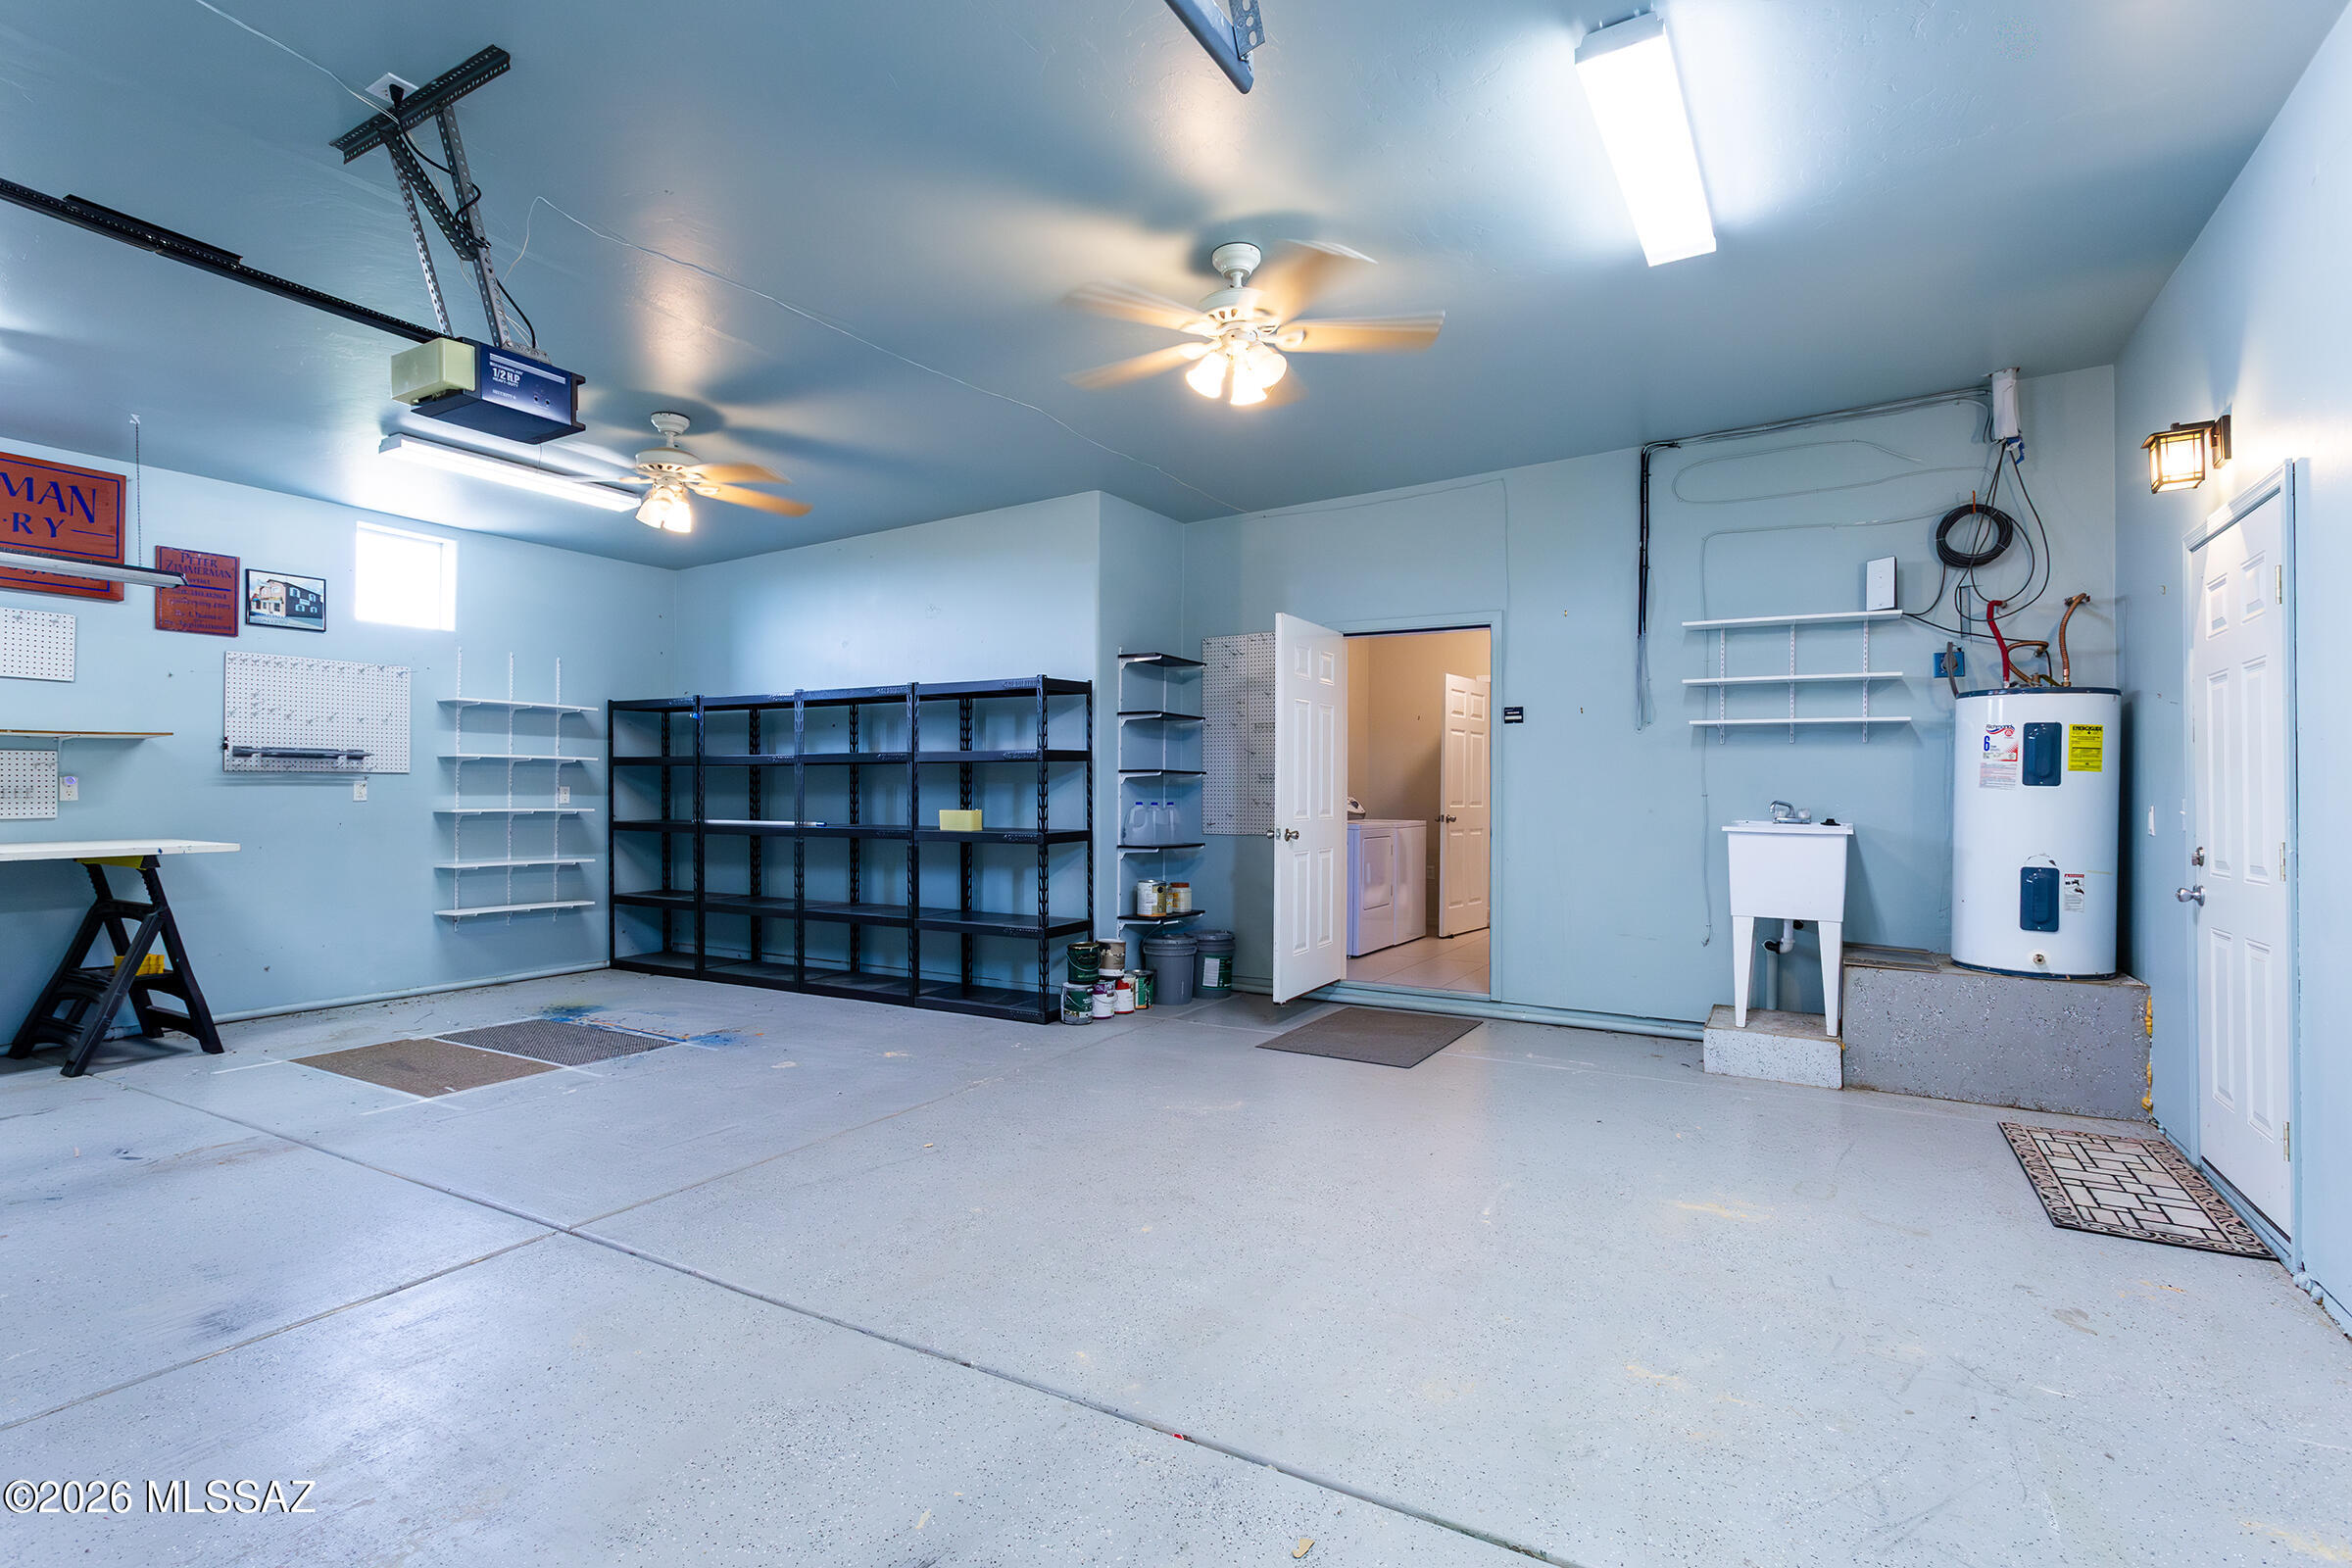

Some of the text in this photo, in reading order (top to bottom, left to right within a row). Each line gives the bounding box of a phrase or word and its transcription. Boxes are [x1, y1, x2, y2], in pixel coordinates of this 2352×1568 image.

[492, 368, 507, 380] 1/2
[165, 560, 232, 579] ZIMMERMAN
[1984, 735, 1990, 752] 6
